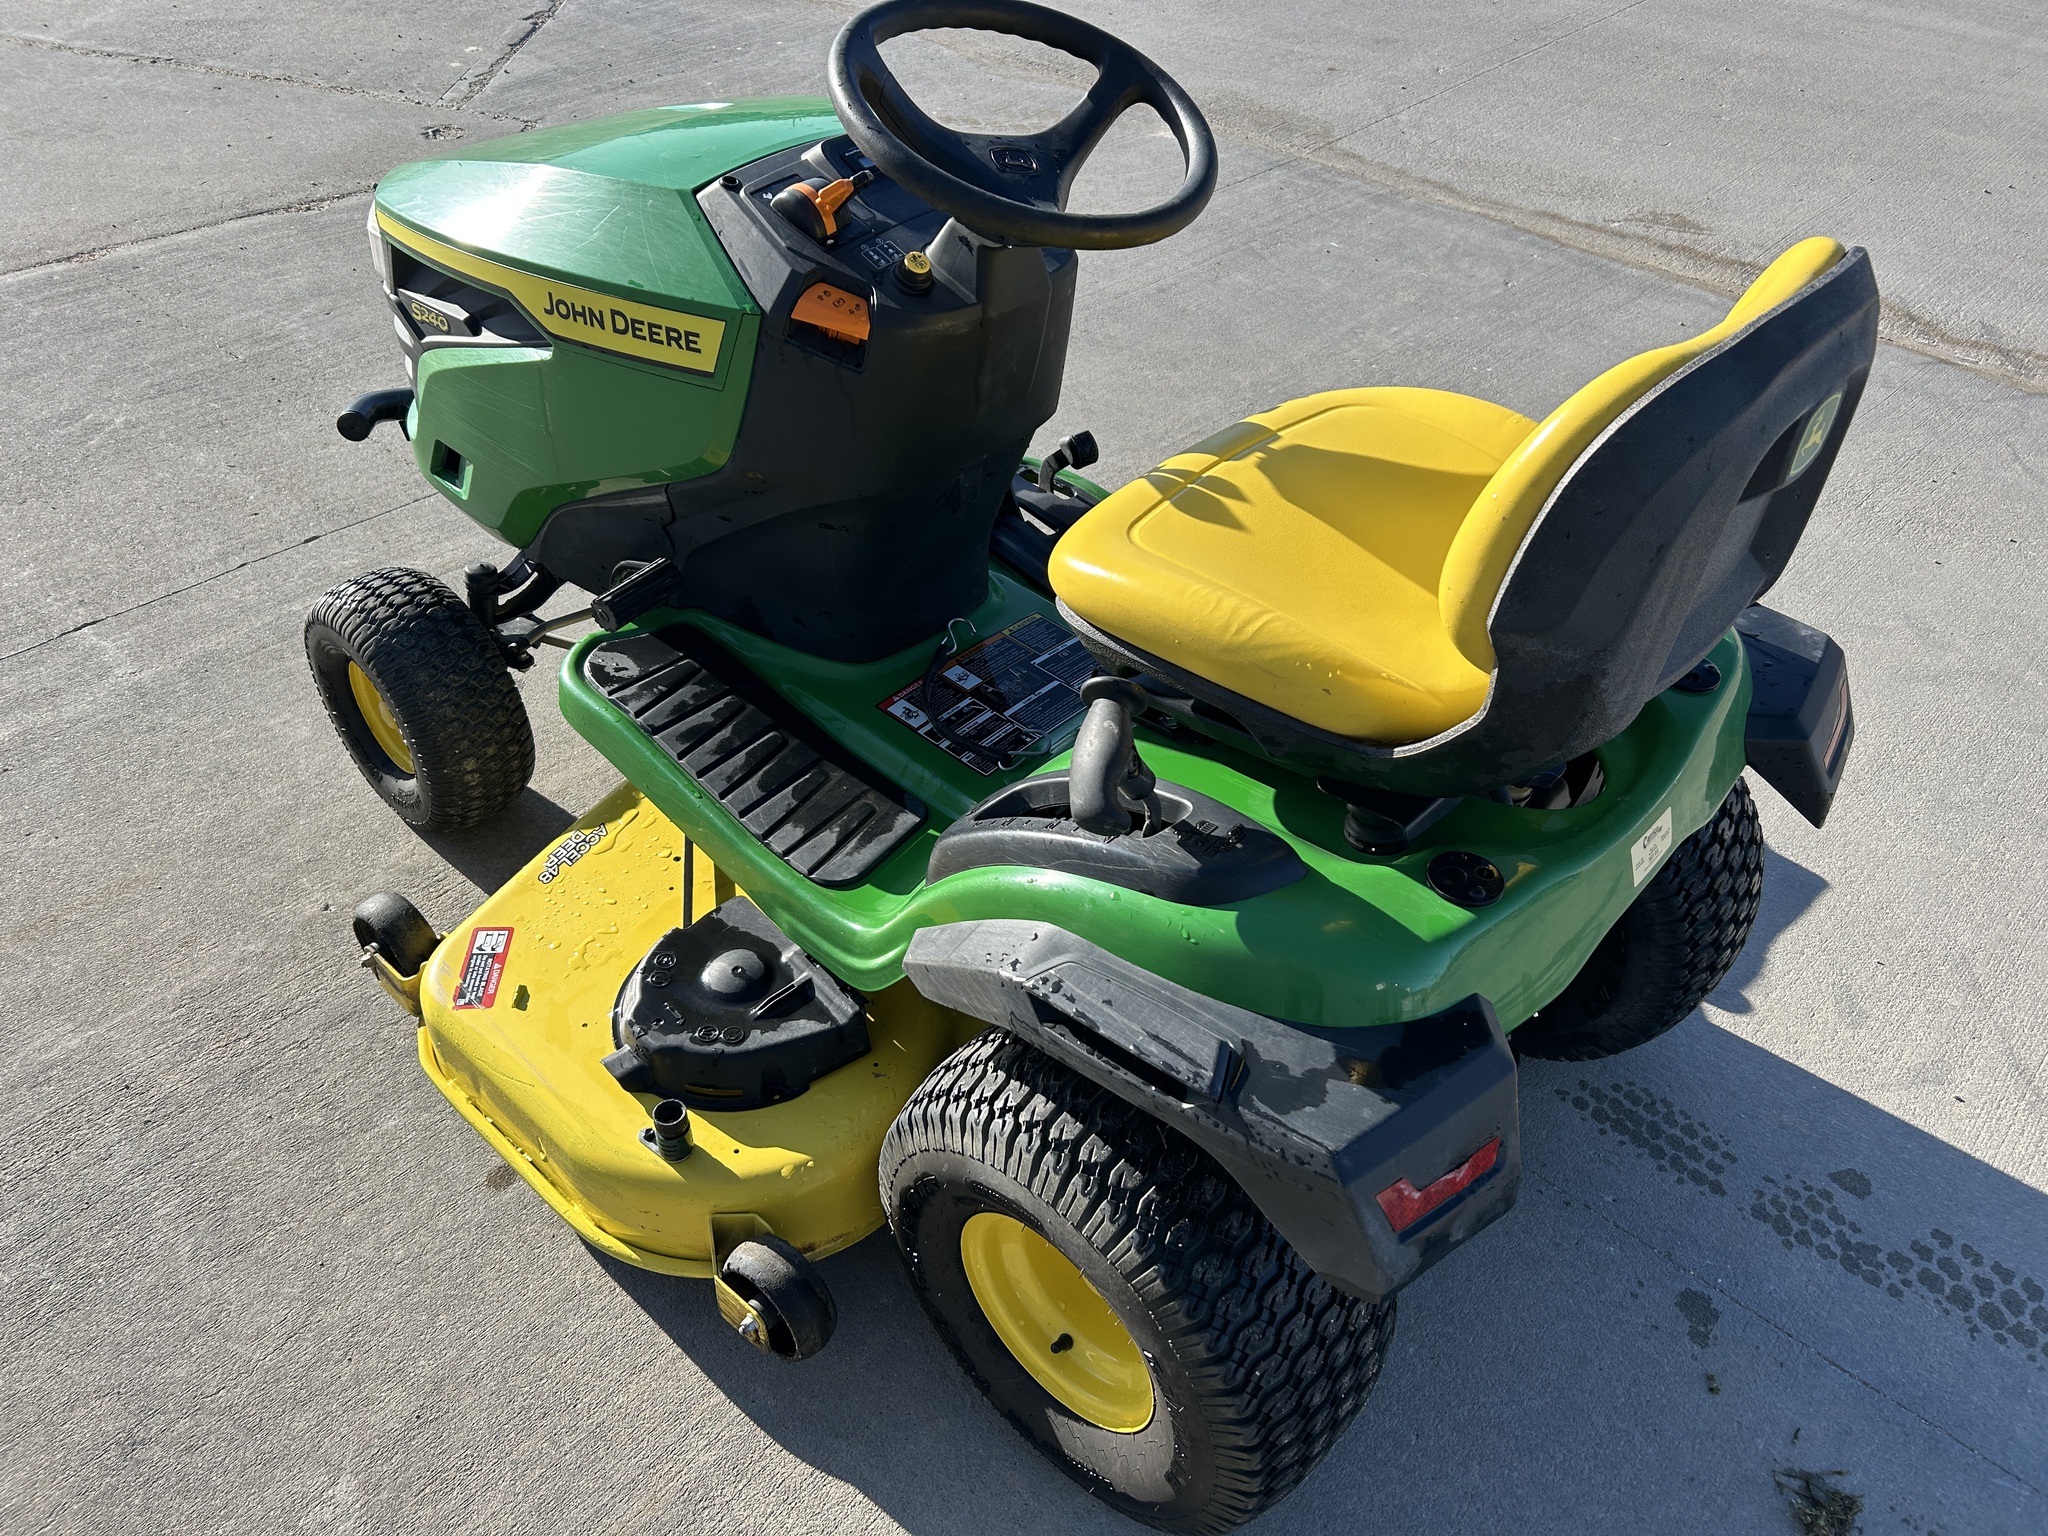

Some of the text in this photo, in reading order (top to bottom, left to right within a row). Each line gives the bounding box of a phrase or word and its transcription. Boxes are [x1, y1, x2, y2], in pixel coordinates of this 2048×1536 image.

[411, 302, 449, 331] S240
[543, 291, 702, 354] JOHN DEERE
[545, 829, 587, 868] DEEP
[557, 822, 609, 868] ACCEL
[487, 969, 500, 995] DANGER
